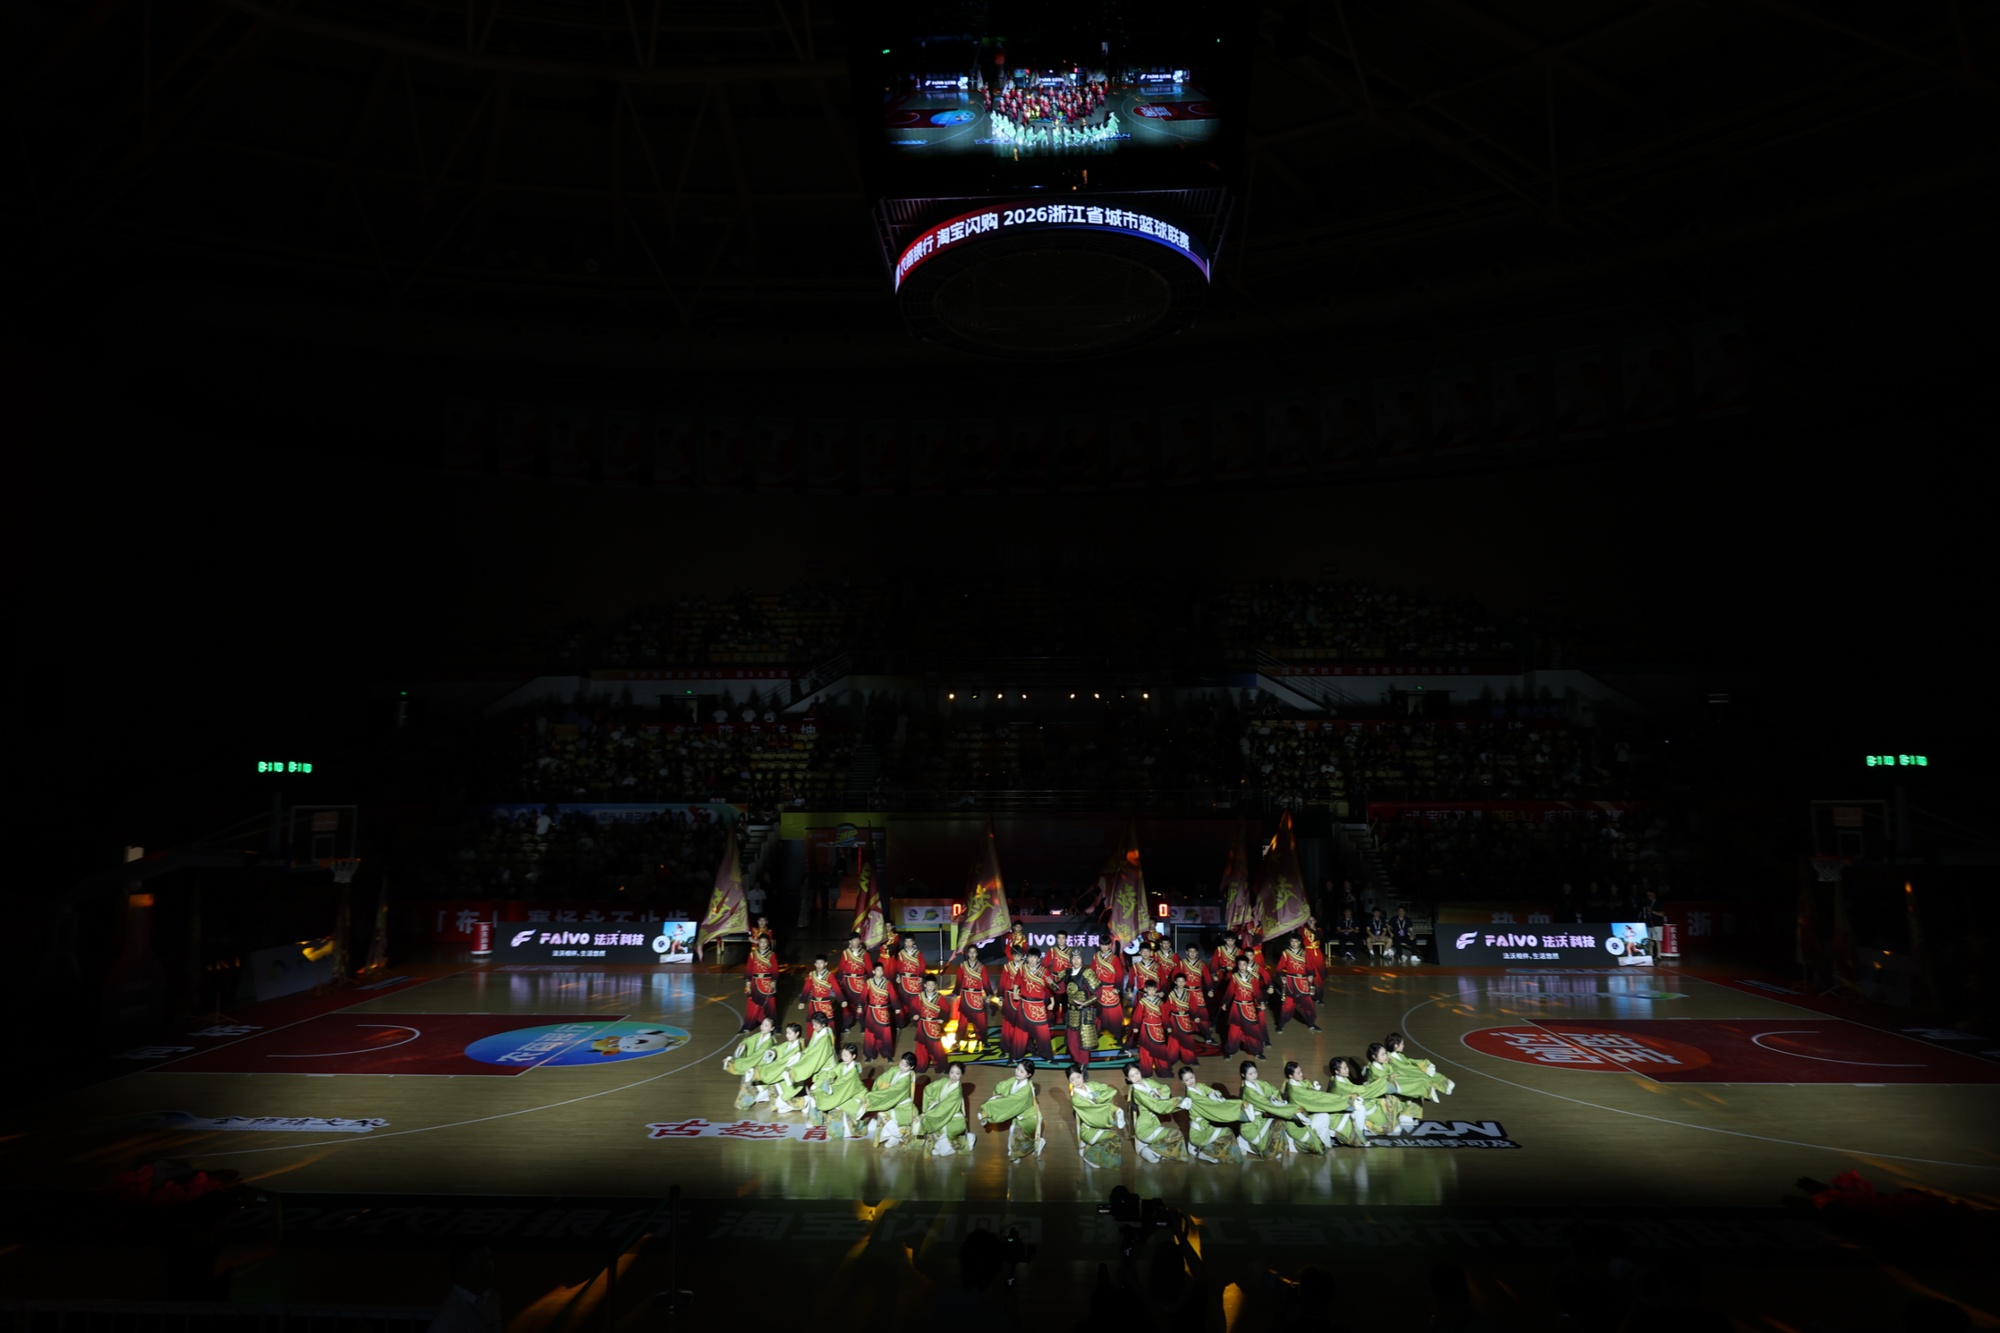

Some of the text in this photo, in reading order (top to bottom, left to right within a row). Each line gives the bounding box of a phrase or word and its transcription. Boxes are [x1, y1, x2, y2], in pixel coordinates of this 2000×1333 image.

[937, 212, 999, 249] 淘宝闪购
[1003, 205, 1191, 252] 2026浙江省城市篮球联赛
[594, 930, 645, 946] 法沃科技
[1542, 932, 1597, 948] 法沃科技
